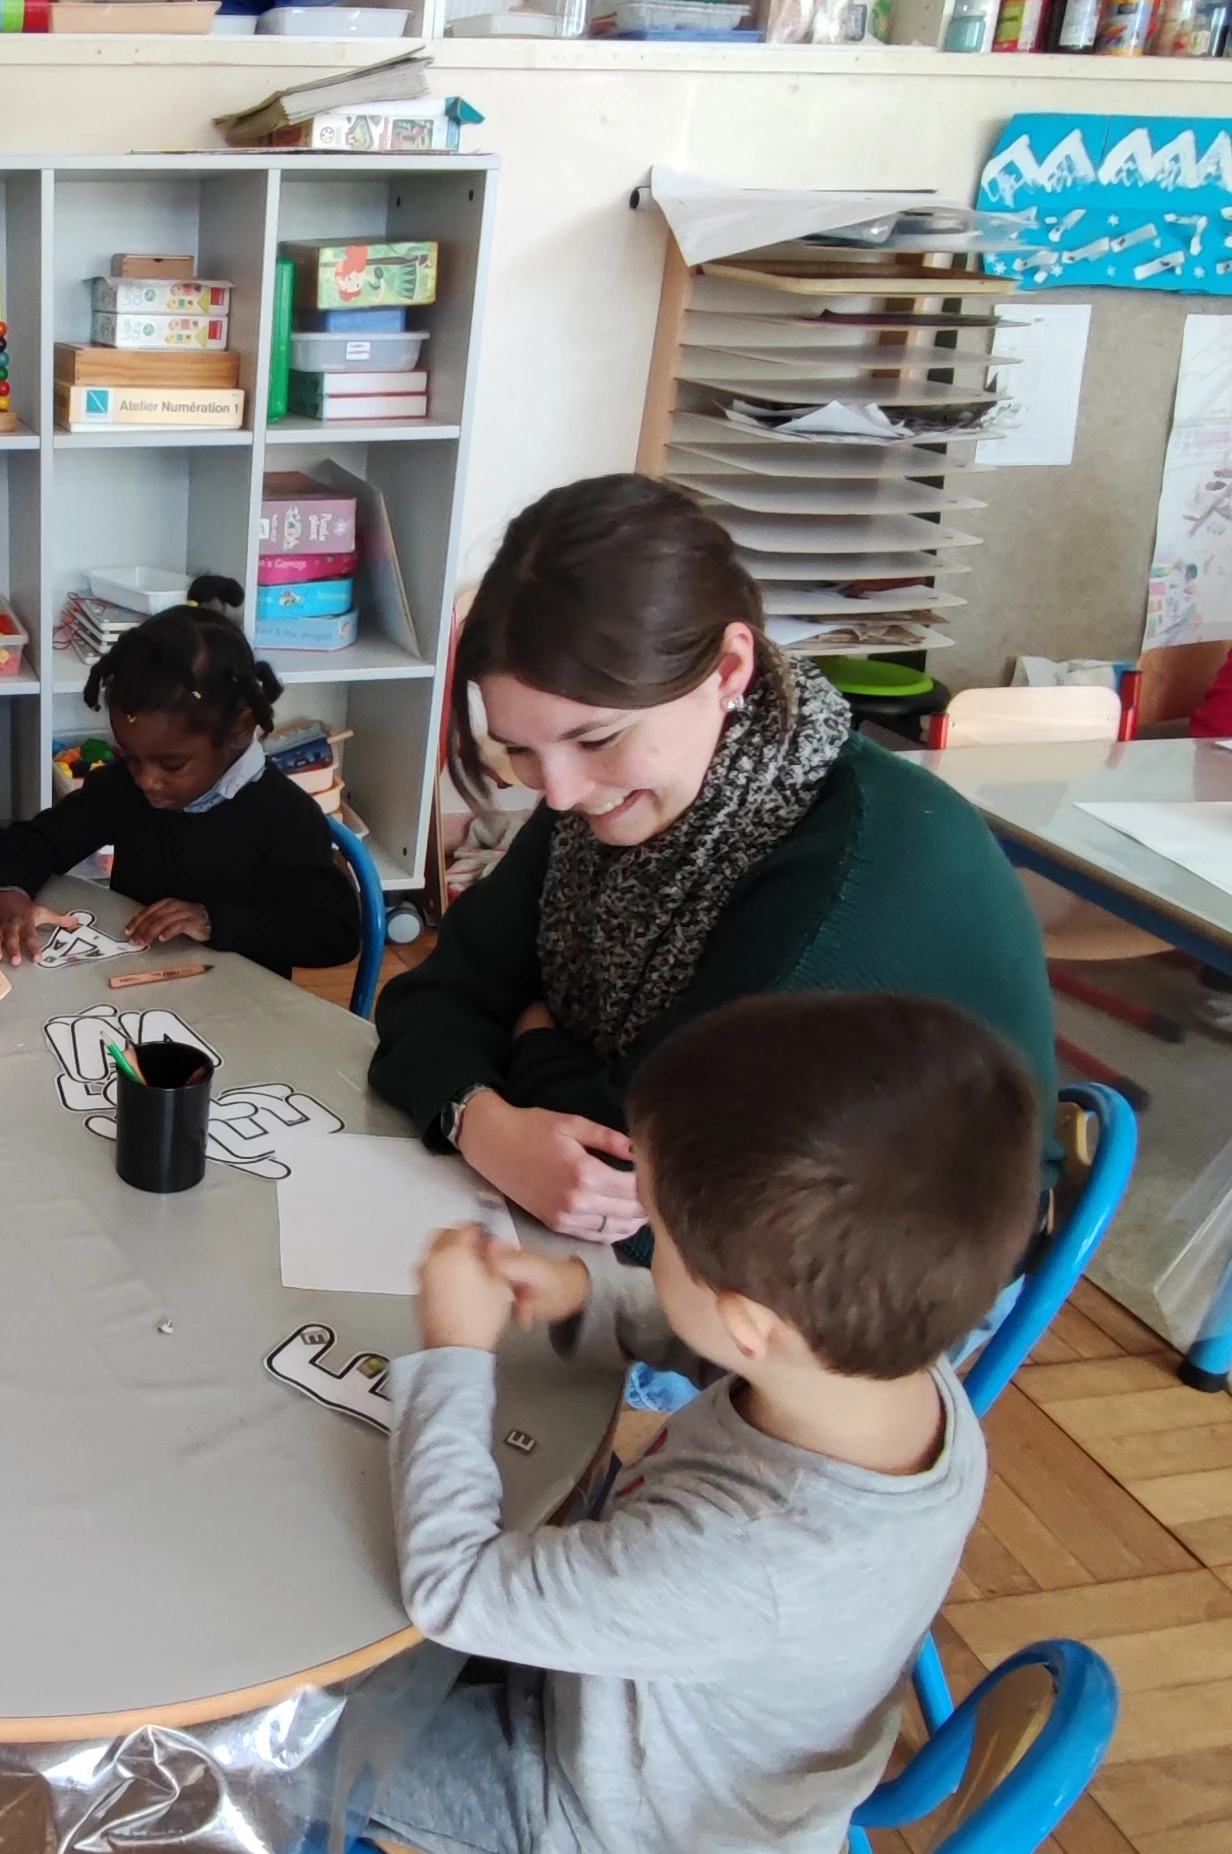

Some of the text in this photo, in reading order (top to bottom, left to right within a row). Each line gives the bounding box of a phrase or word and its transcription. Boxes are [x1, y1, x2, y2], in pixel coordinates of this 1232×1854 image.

[120, 400, 239, 414] Atelier Numération 1
[507, 1430, 535, 1452] E
